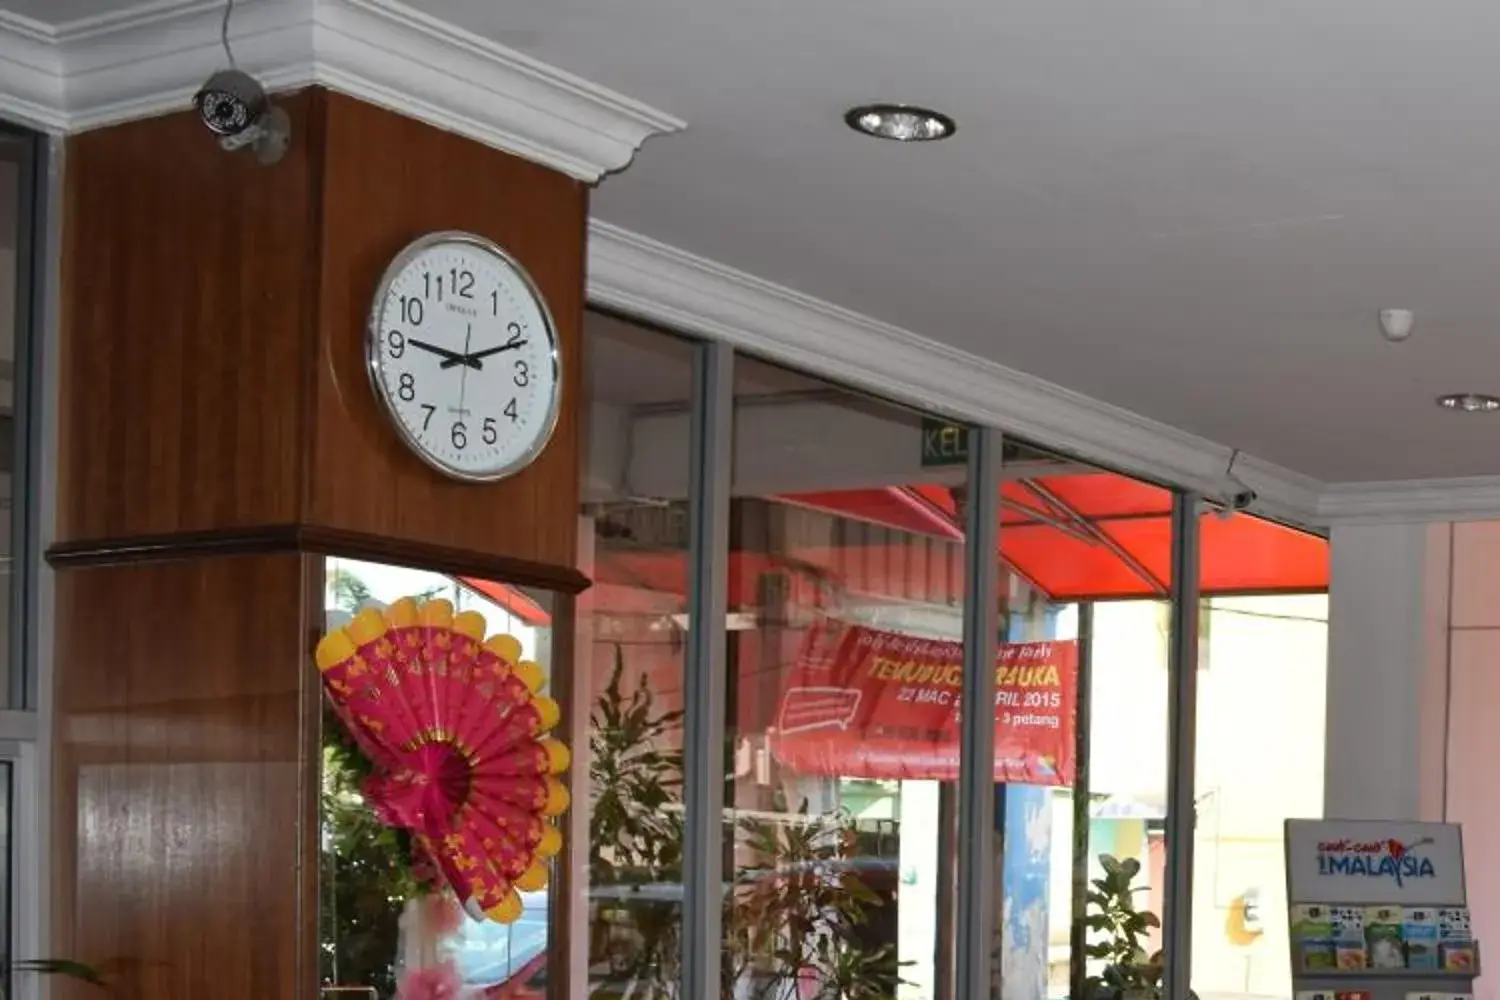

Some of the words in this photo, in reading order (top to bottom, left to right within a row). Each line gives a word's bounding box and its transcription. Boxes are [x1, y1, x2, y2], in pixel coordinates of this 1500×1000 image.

[423, 271, 443, 303] 11
[450, 268, 476, 299] 12
[399, 297, 424, 326] 10
[491, 290, 498, 317] 1
[387, 330, 405, 359] 9
[507, 322, 523, 349] 2
[398, 373, 416, 402] 8
[513, 360, 530, 388] 3
[420, 404, 438, 431] 7
[503, 397, 519, 423] 4
[451, 421, 467, 450] 6
[482, 417, 498, 445] 5
[995, 690, 1020, 707] RIL
[1023, 691, 1062, 708] 2015
[1012, 712, 1060, 729] petang
